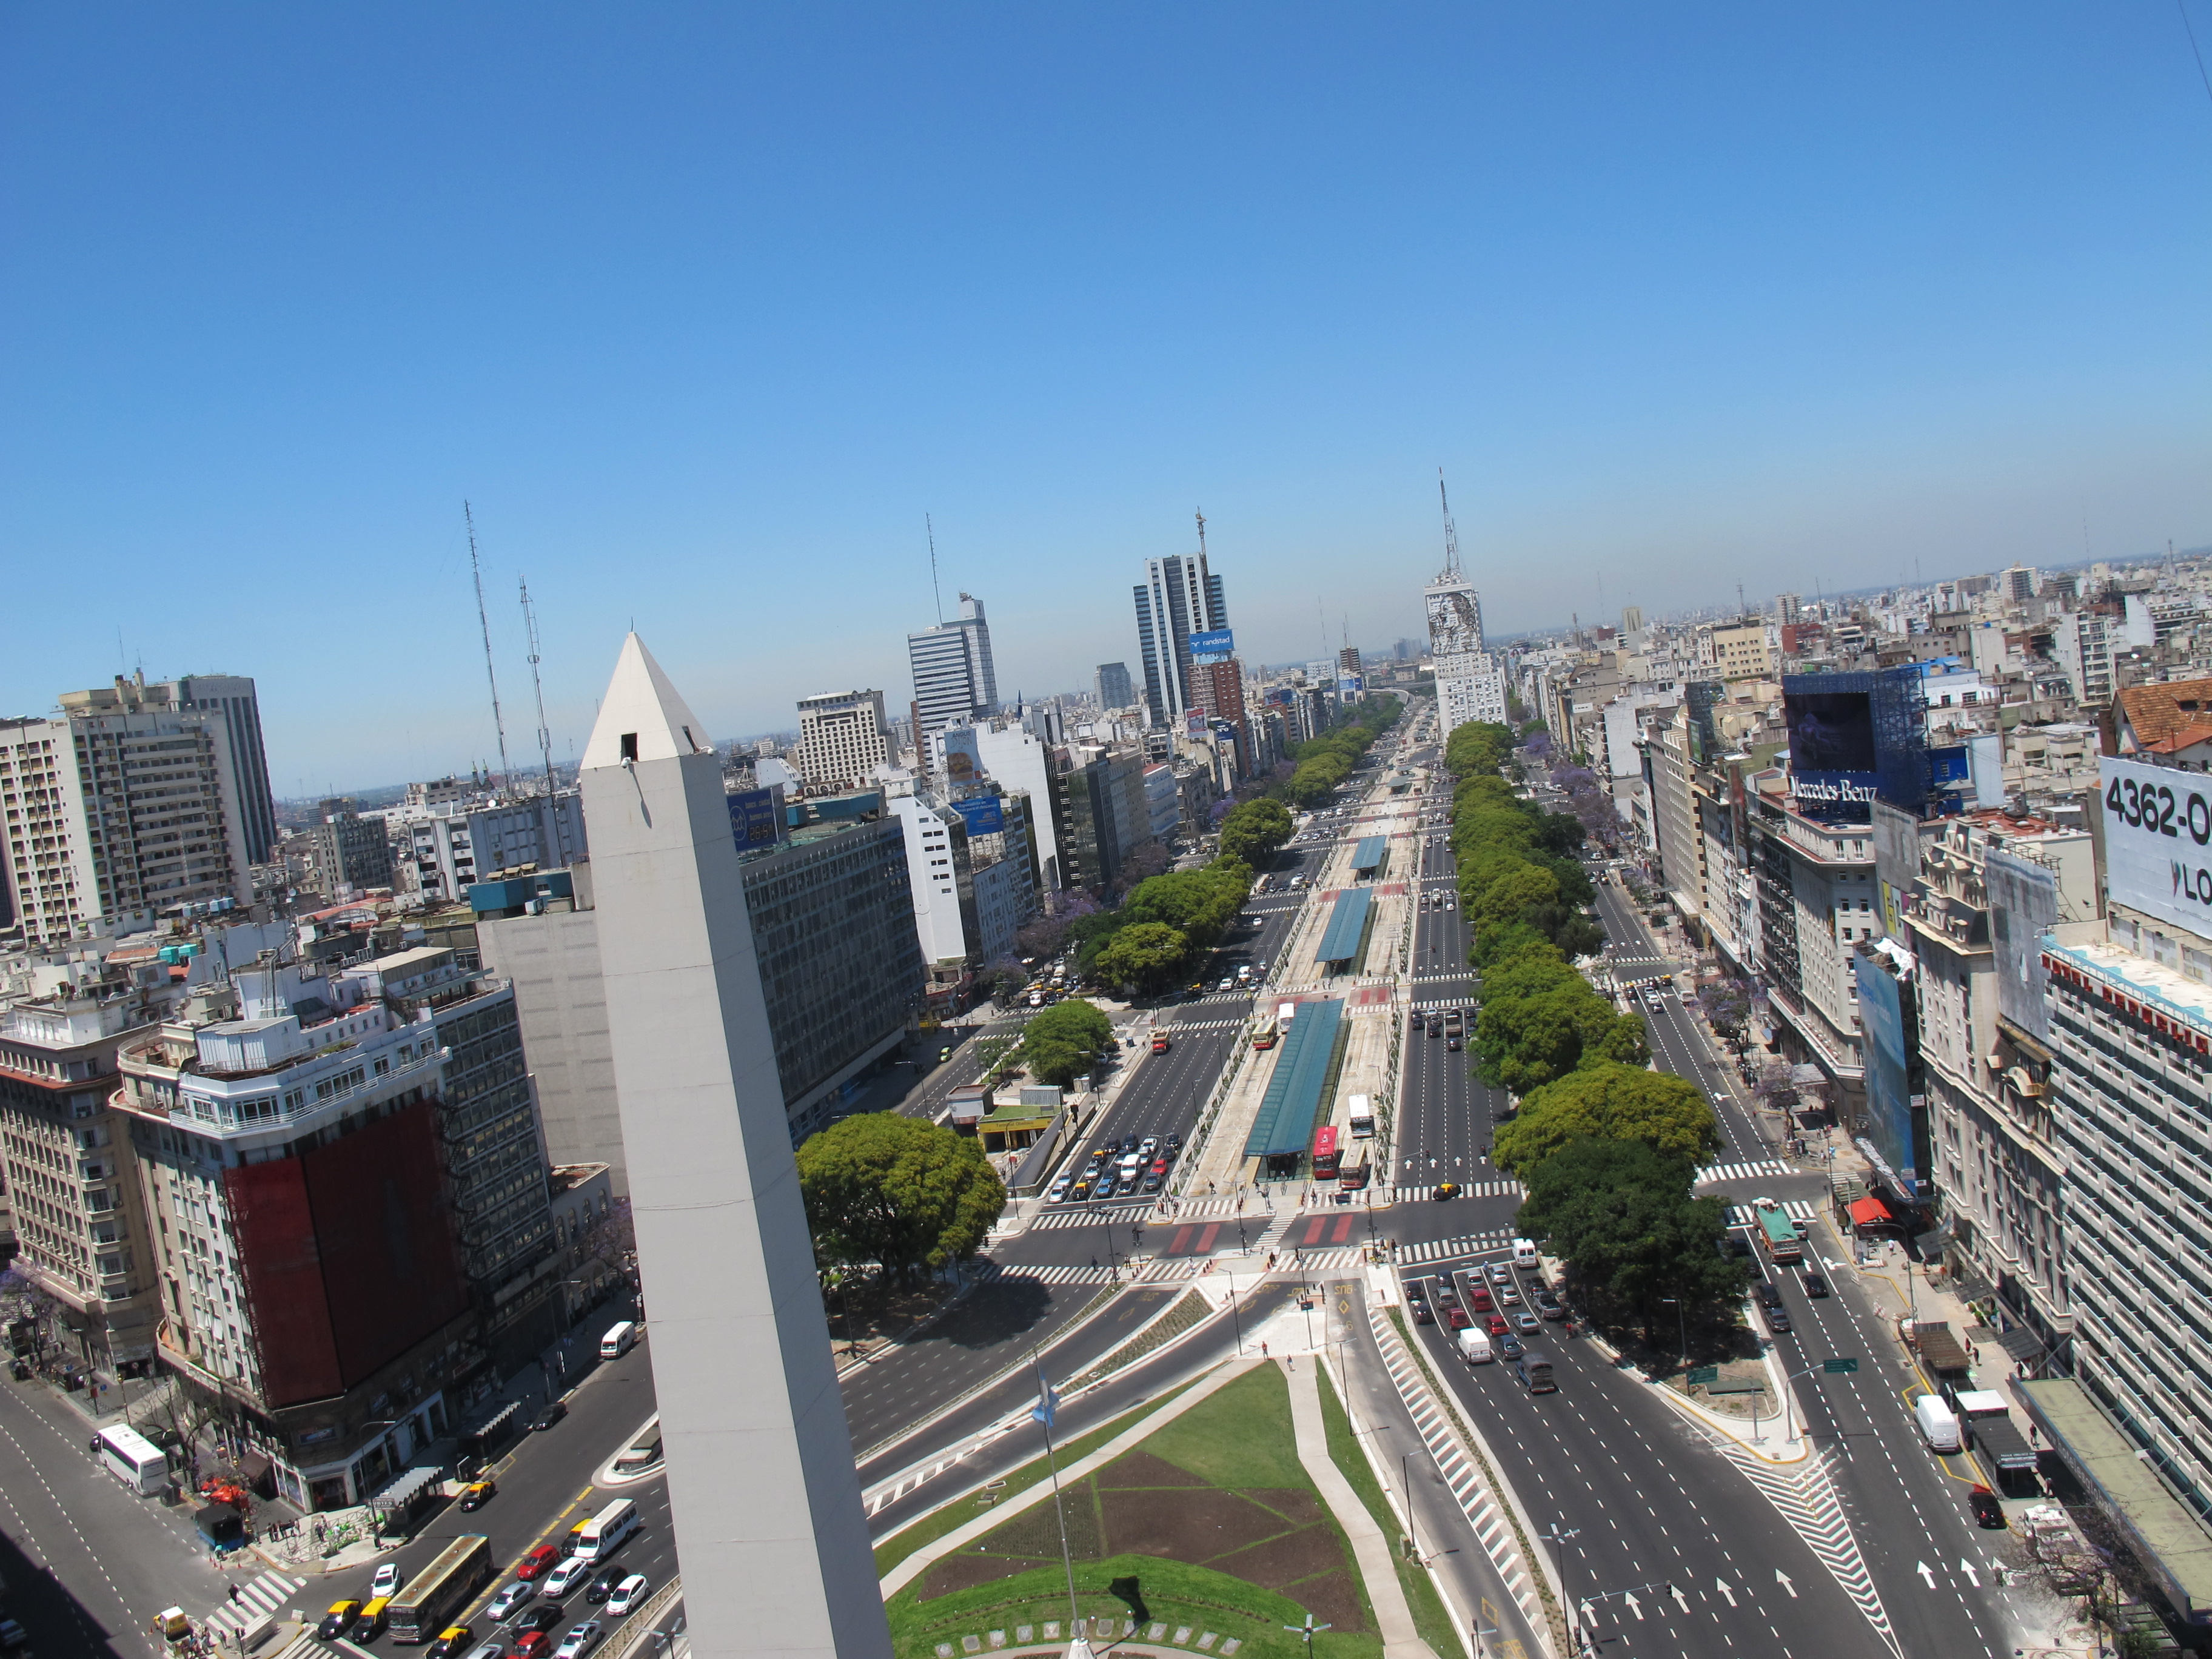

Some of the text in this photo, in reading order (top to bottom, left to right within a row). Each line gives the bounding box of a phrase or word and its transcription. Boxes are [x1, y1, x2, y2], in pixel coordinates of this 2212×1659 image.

[1202, 636, 1230, 646] randstad
[1789, 775, 1877, 802] Mercedes-Benz
[2106, 776, 2212, 846] 4362-0
[1335, 1284, 1353, 1295] BUS
